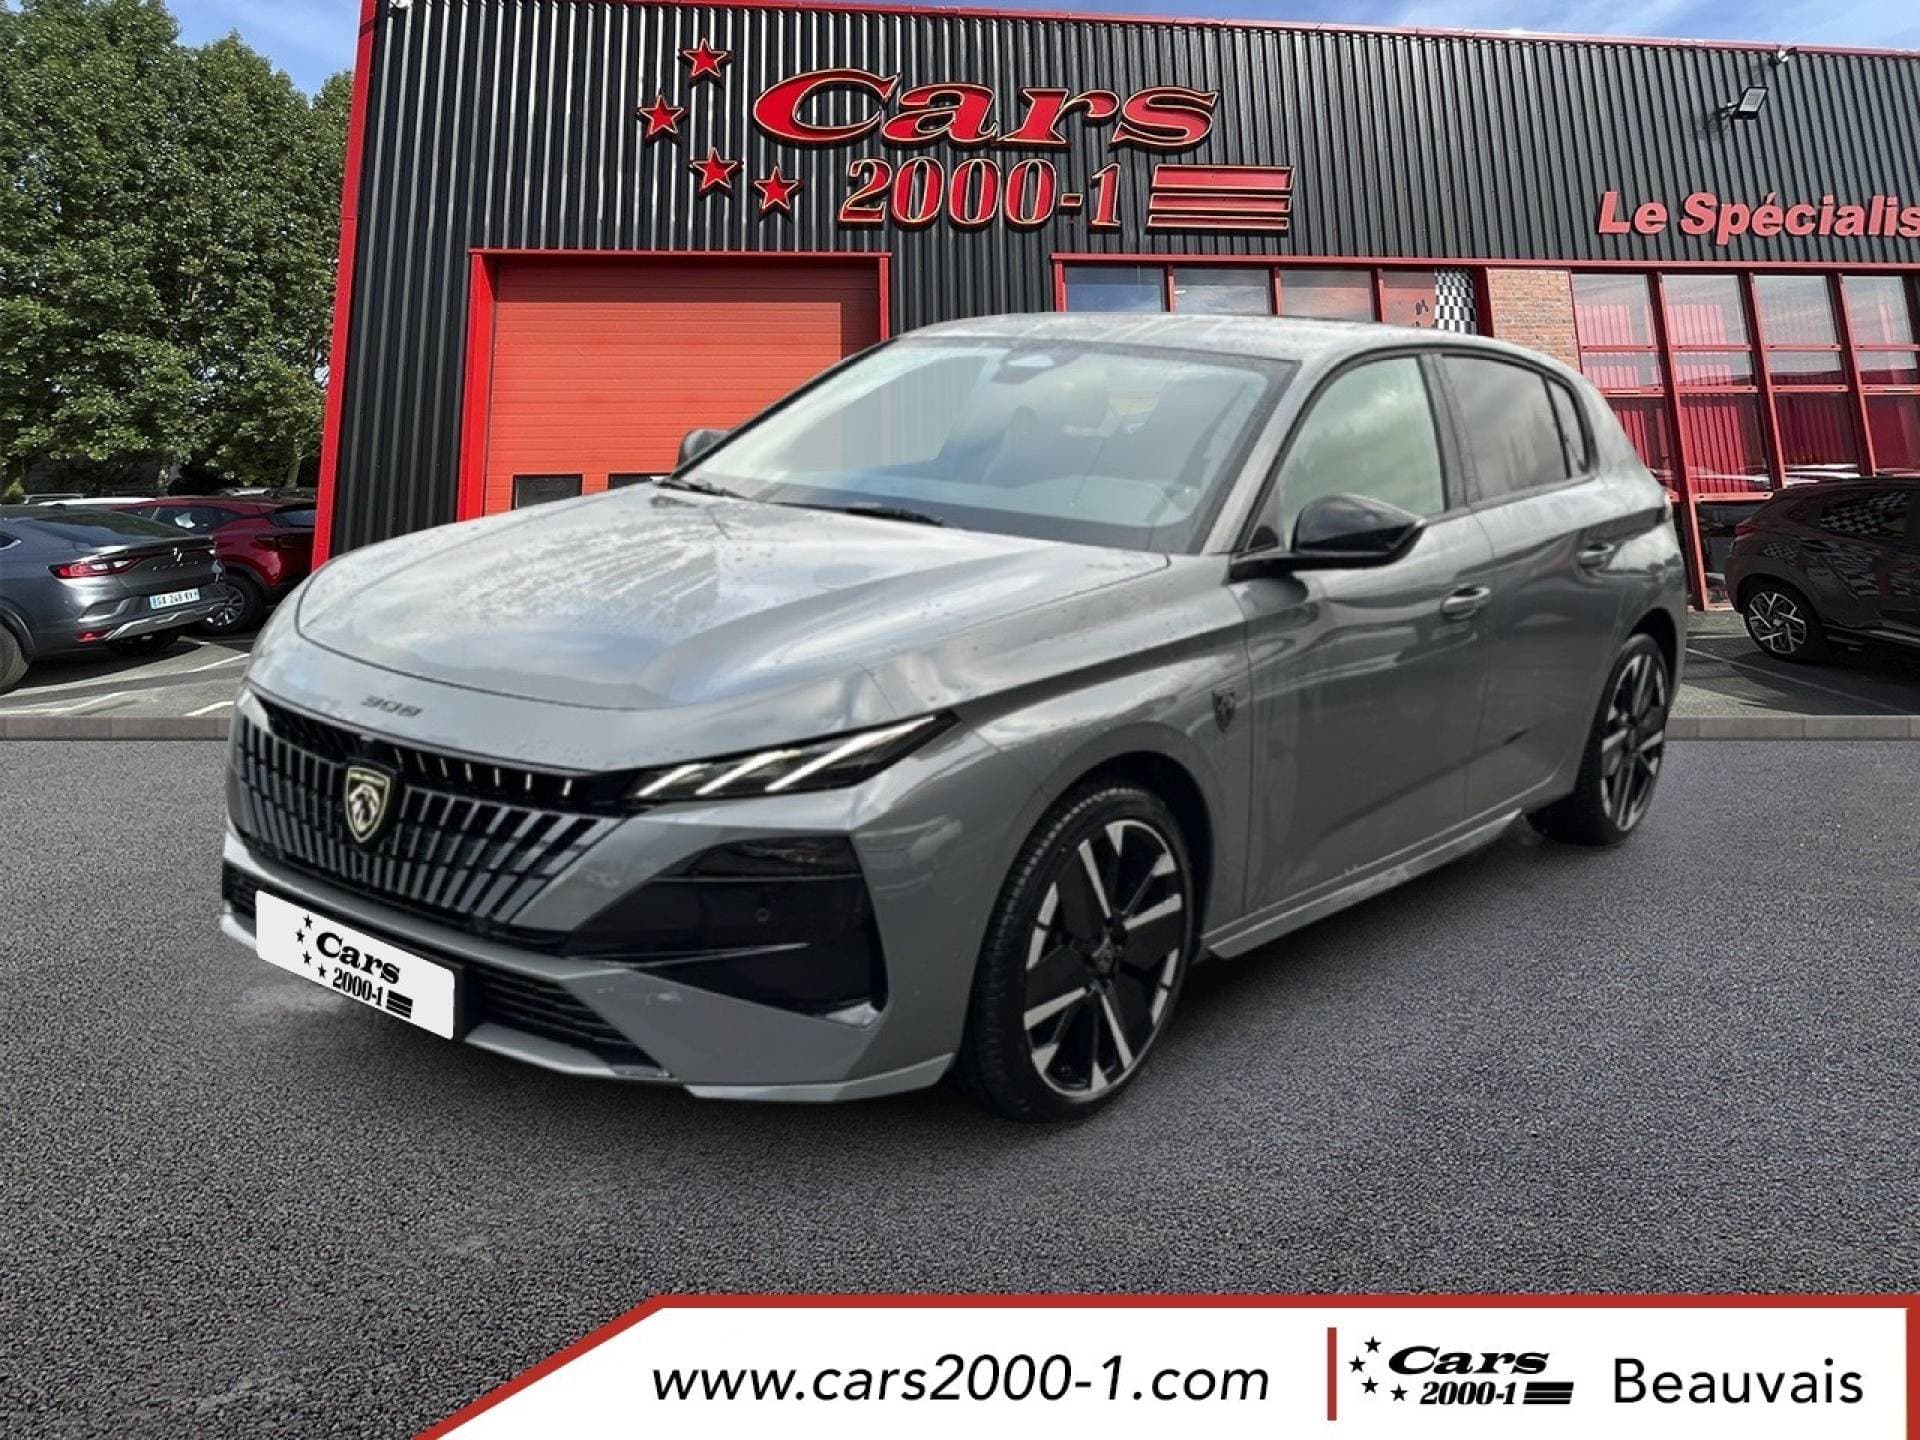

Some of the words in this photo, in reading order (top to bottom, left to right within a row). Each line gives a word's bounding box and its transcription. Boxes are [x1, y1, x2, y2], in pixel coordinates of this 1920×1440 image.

[752, 68, 1219, 147] Cars
[838, 156, 1122, 230] 2000-1
[1599, 191, 1668, 234] Le
